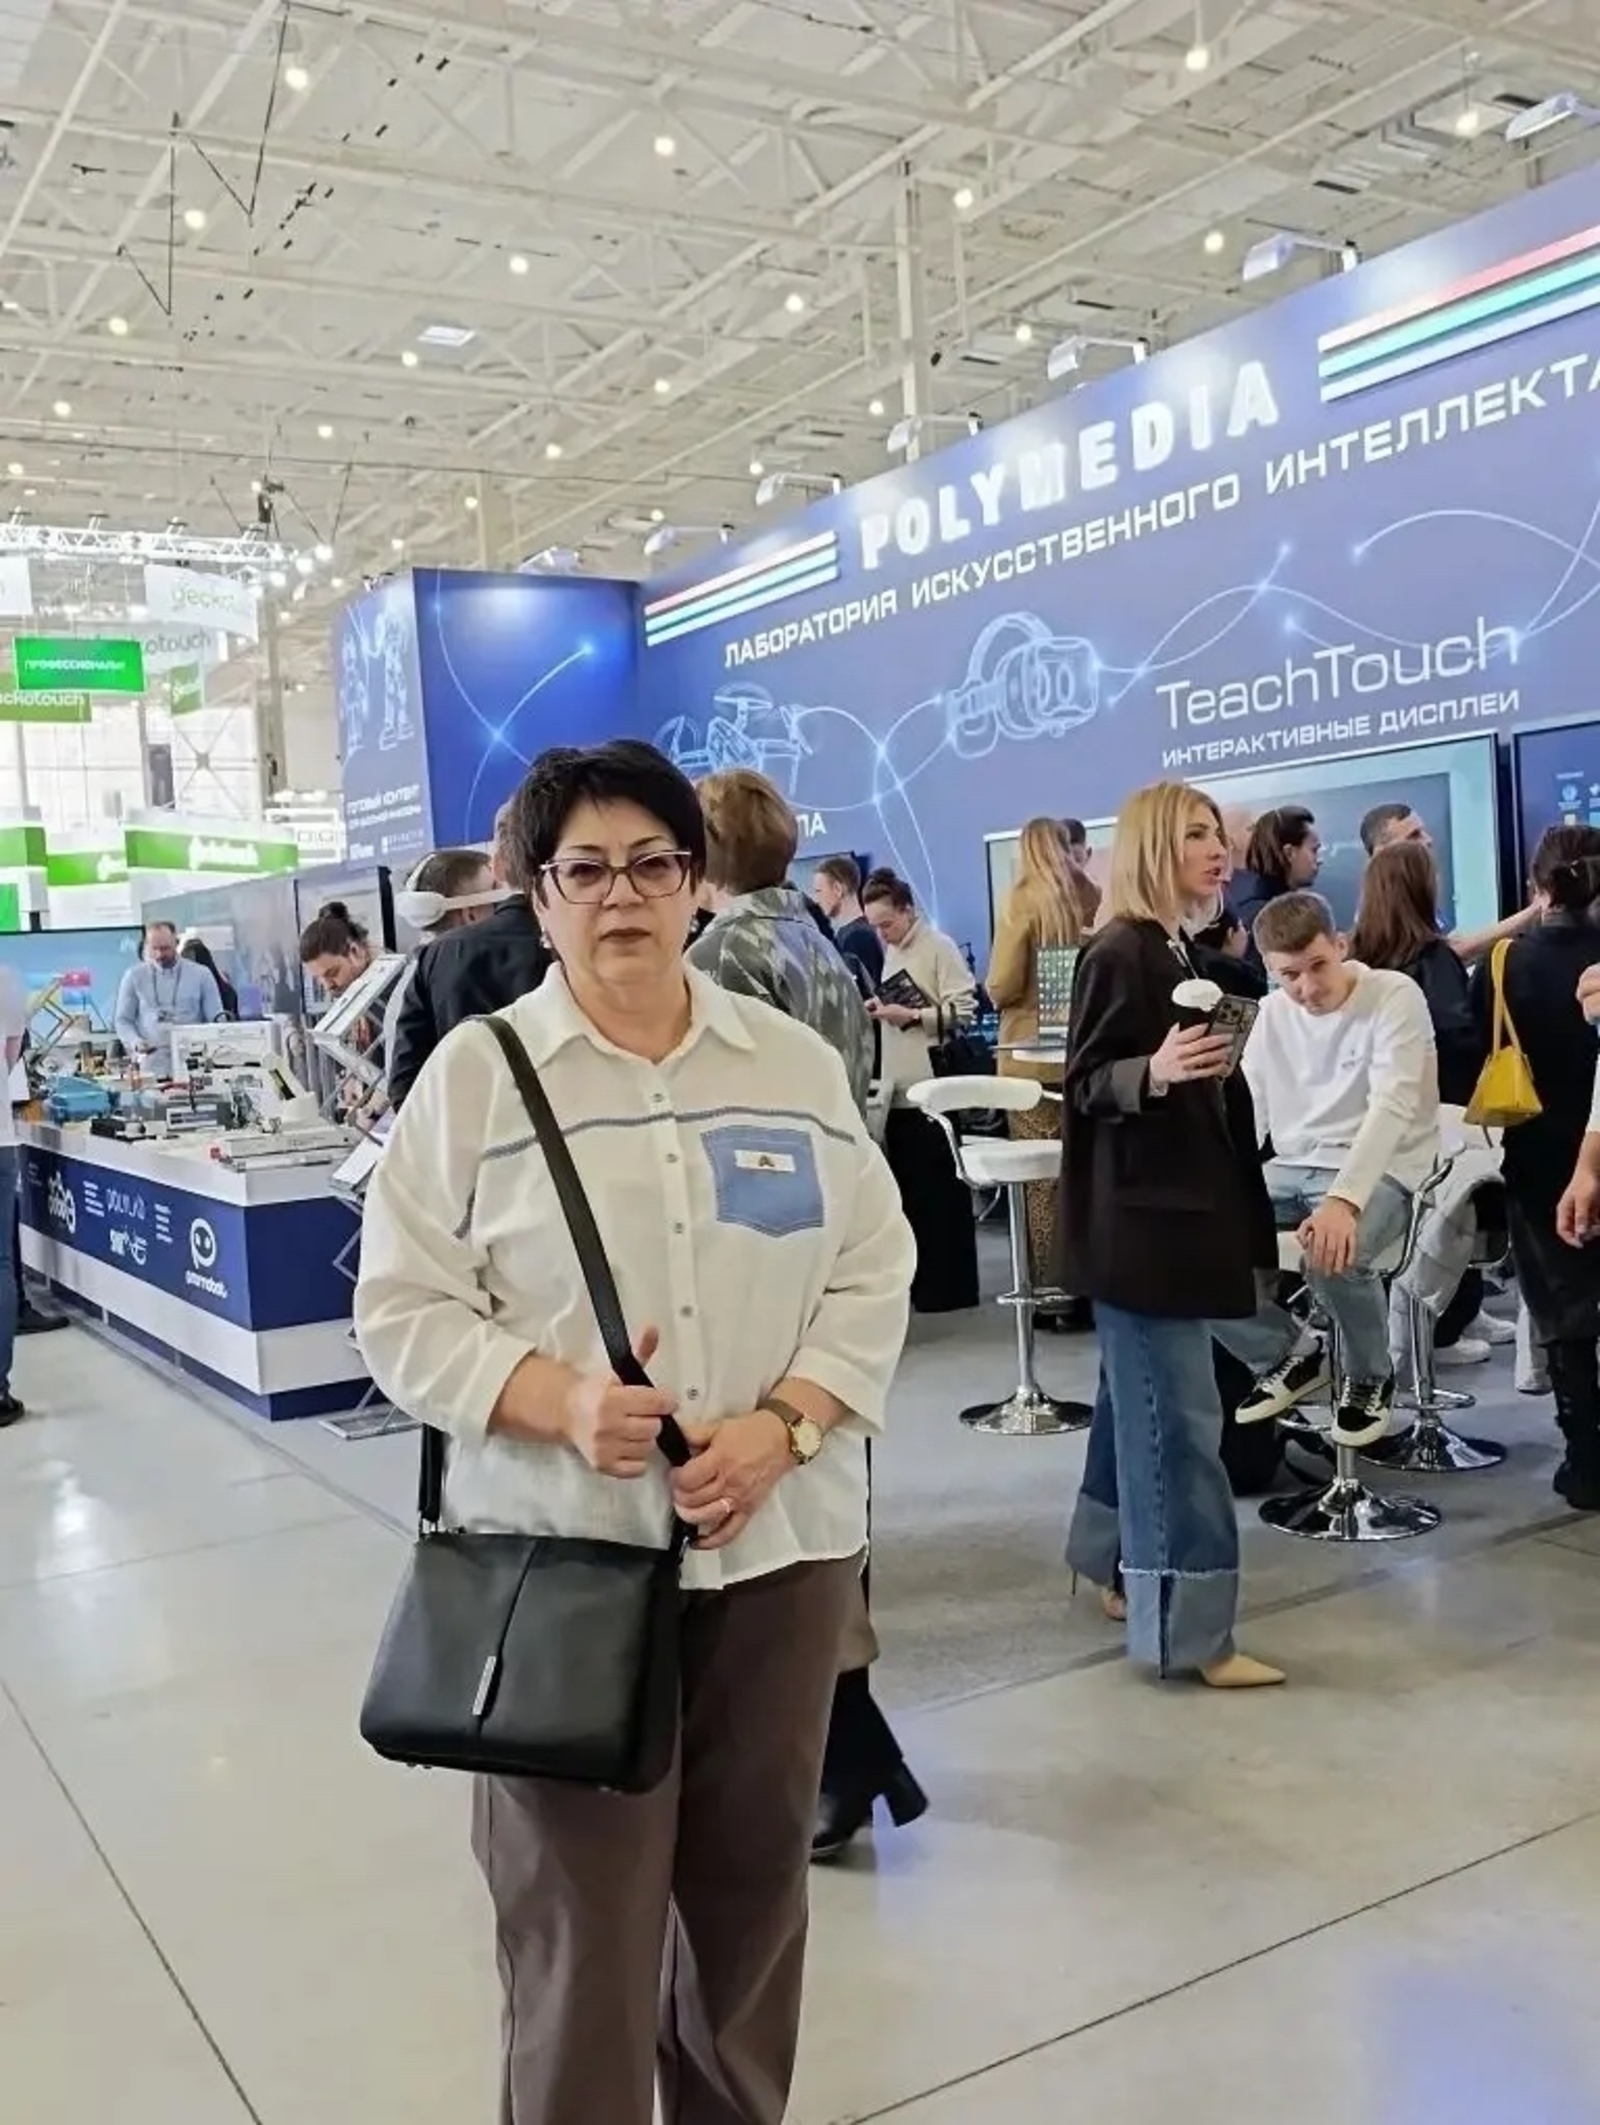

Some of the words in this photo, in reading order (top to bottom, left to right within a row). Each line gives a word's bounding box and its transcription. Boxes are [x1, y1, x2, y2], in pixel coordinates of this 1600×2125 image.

[861, 360, 1279, 569] POLYMEDIA
[725, 589, 897, 668] ЛАБОРАТОРИЯ
[911, 473, 1240, 608] ИСКУССТВЕННОГО
[1155, 616, 1518, 729] TeachTouch
[1162, 715, 1370, 768] ИНТЕРАКТИВНЫЕ
[1379, 690, 1520, 734] ДИСПЛЕИ
